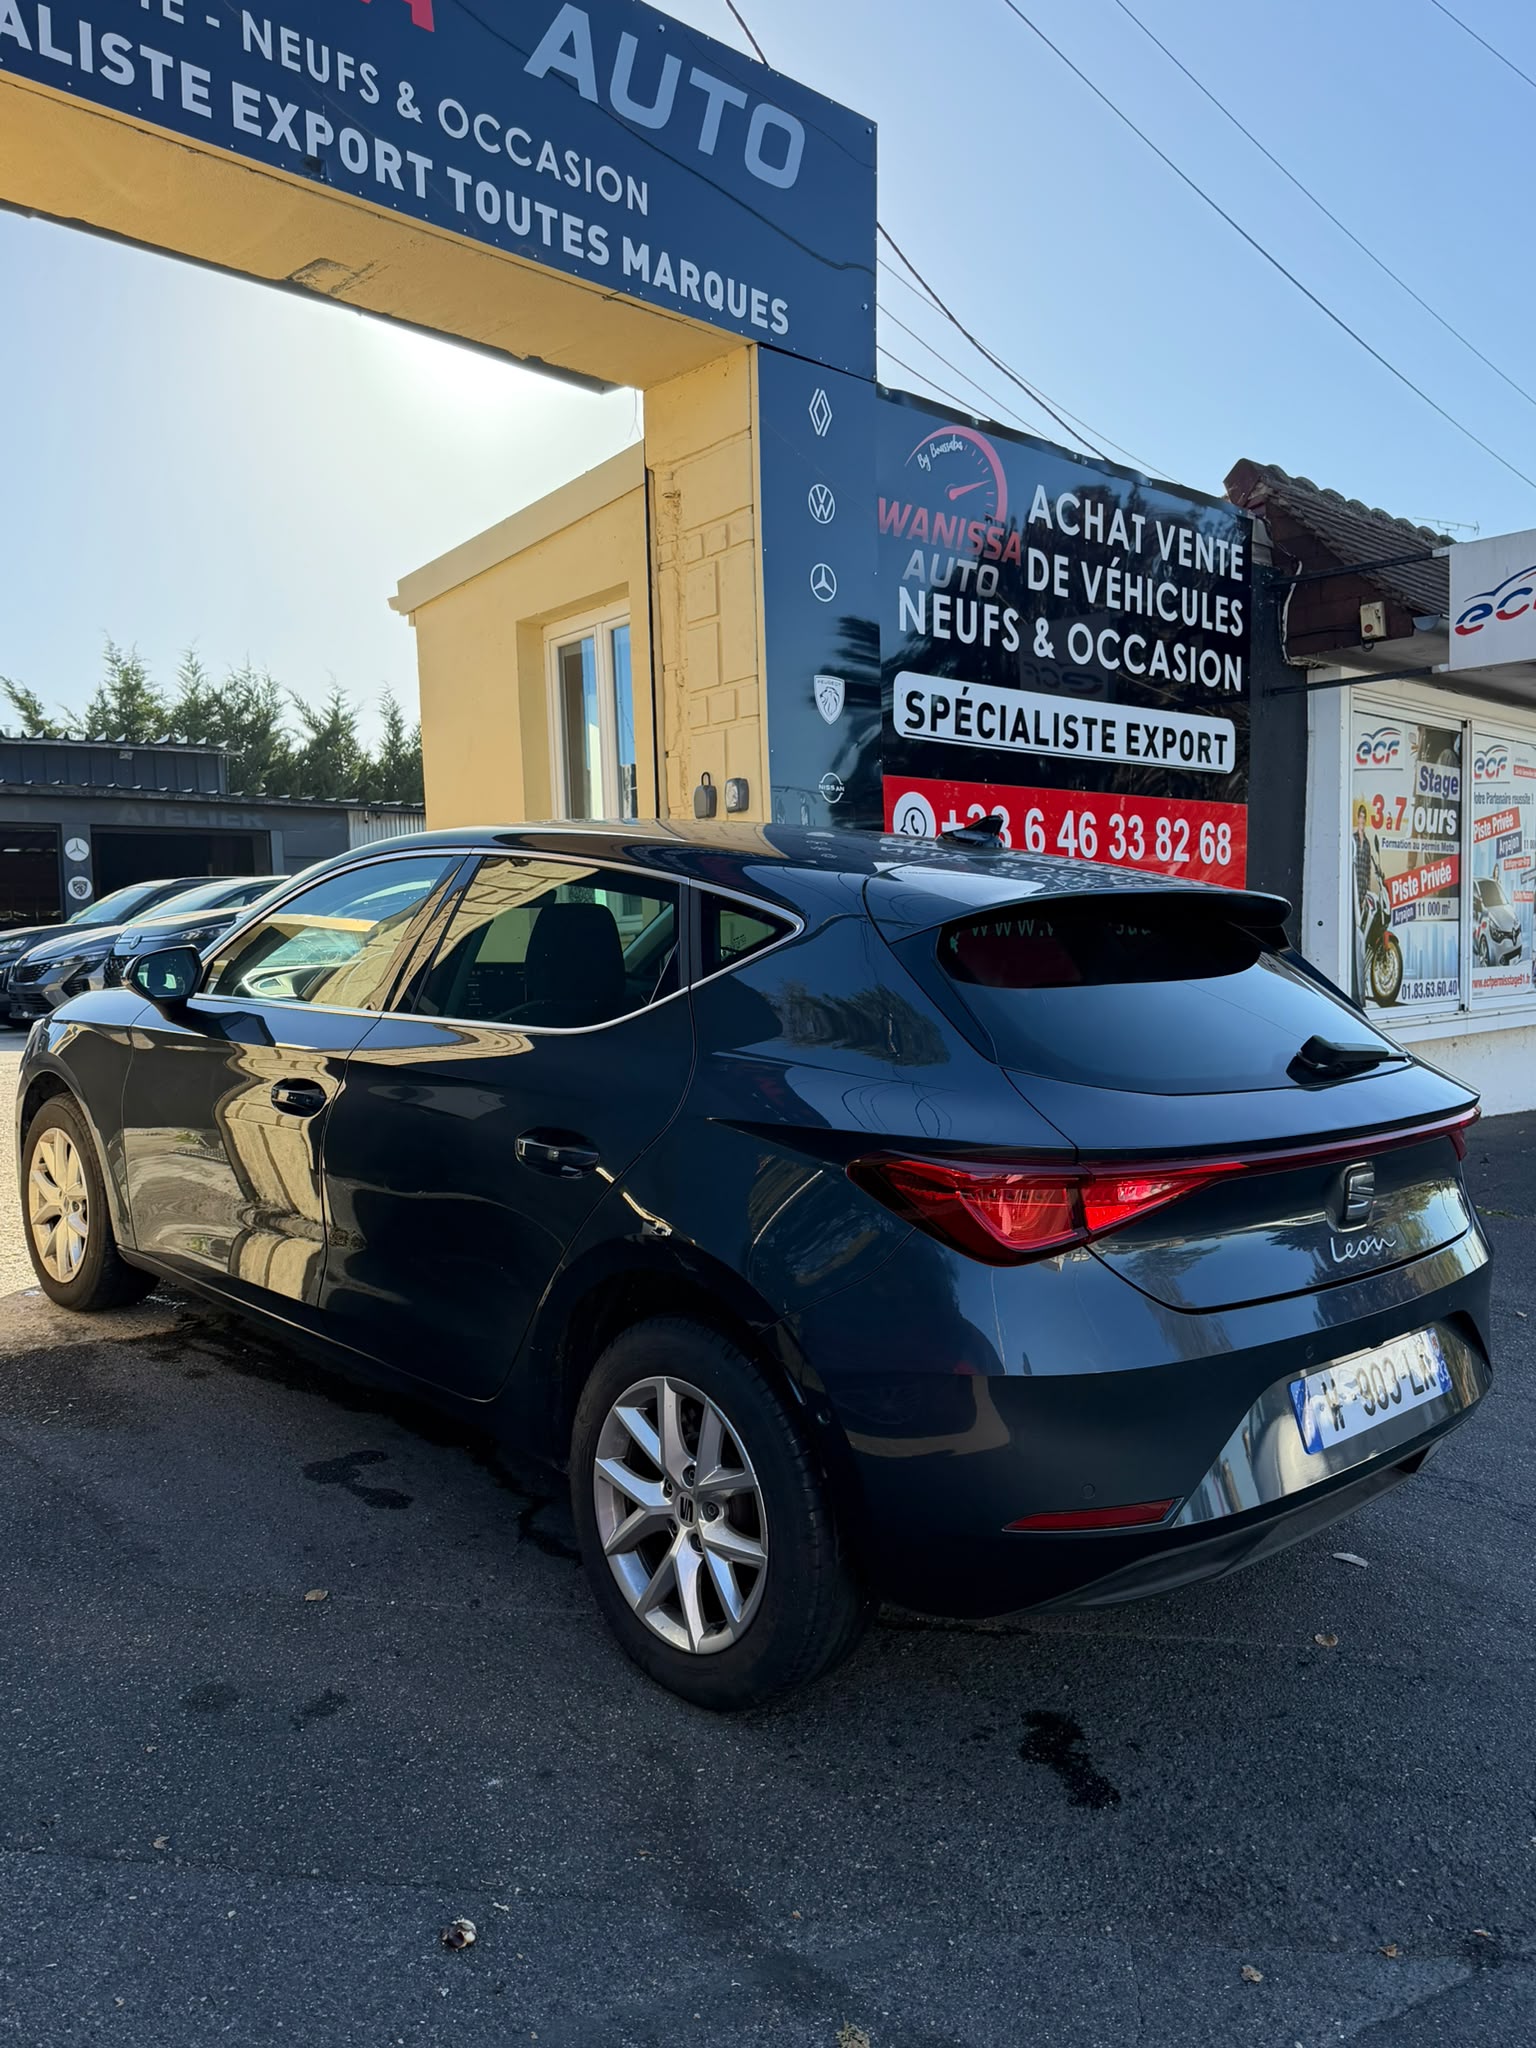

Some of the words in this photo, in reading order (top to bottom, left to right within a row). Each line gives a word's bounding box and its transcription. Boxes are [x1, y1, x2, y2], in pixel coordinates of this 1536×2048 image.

[242, 10, 380, 105] NEUFS
[396, 80, 423, 123] &
[438, 98, 648, 216] OCCASION
[524, 3, 806, 189] AUTO
[231, 80, 433, 199] EXPORT
[446, 166, 610, 266] TOUTES
[622, 236, 789, 335] MARQUES
[917, 453, 931, 471] By
[878, 496, 1022, 566] WANISSA
[1028, 484, 1146, 552] ACHAT
[1156, 524, 1245, 582] VENTE
[902, 549, 1000, 598] AUTO
[1027, 548, 1069, 598] DE
[1081, 552, 1244, 638] VÉHICULES
[899, 586, 1020, 653] NEUFS
[1032, 617, 1056, 660] &
[1068, 622, 1243, 692] OCCASION
[904, 686, 1116, 754] SPÉCIALISTE
[1127, 722, 1229, 765] EXPORT
[1419, 765, 1459, 799] Stage
[1025, 807, 1046, 853] 6
[1057, 809, 1098, 858] 46
[1108, 813, 1146, 861] 33
[1155, 816, 1191, 863] 82
[1199, 821, 1232, 865] 68
[1370, 793, 1385, 830] 3
[1386, 811, 1393, 831] à
[1395, 796, 1408, 831] 7
[1474, 821, 1492, 841] Piste
[1492, 811, 1514, 835] Privée
[1381, 837, 1411, 849] Formation
[1421, 841, 1440, 852] permis
[1391, 878, 1419, 905] Piste
[1420, 863, 1452, 893] Privée
[1418, 901, 1425, 917] 11
[1427, 900, 1441, 916] 000
[1401, 980, 1458, 1000] 01.83.63.60.40
[1329, 1236, 1397, 1264] Leon
